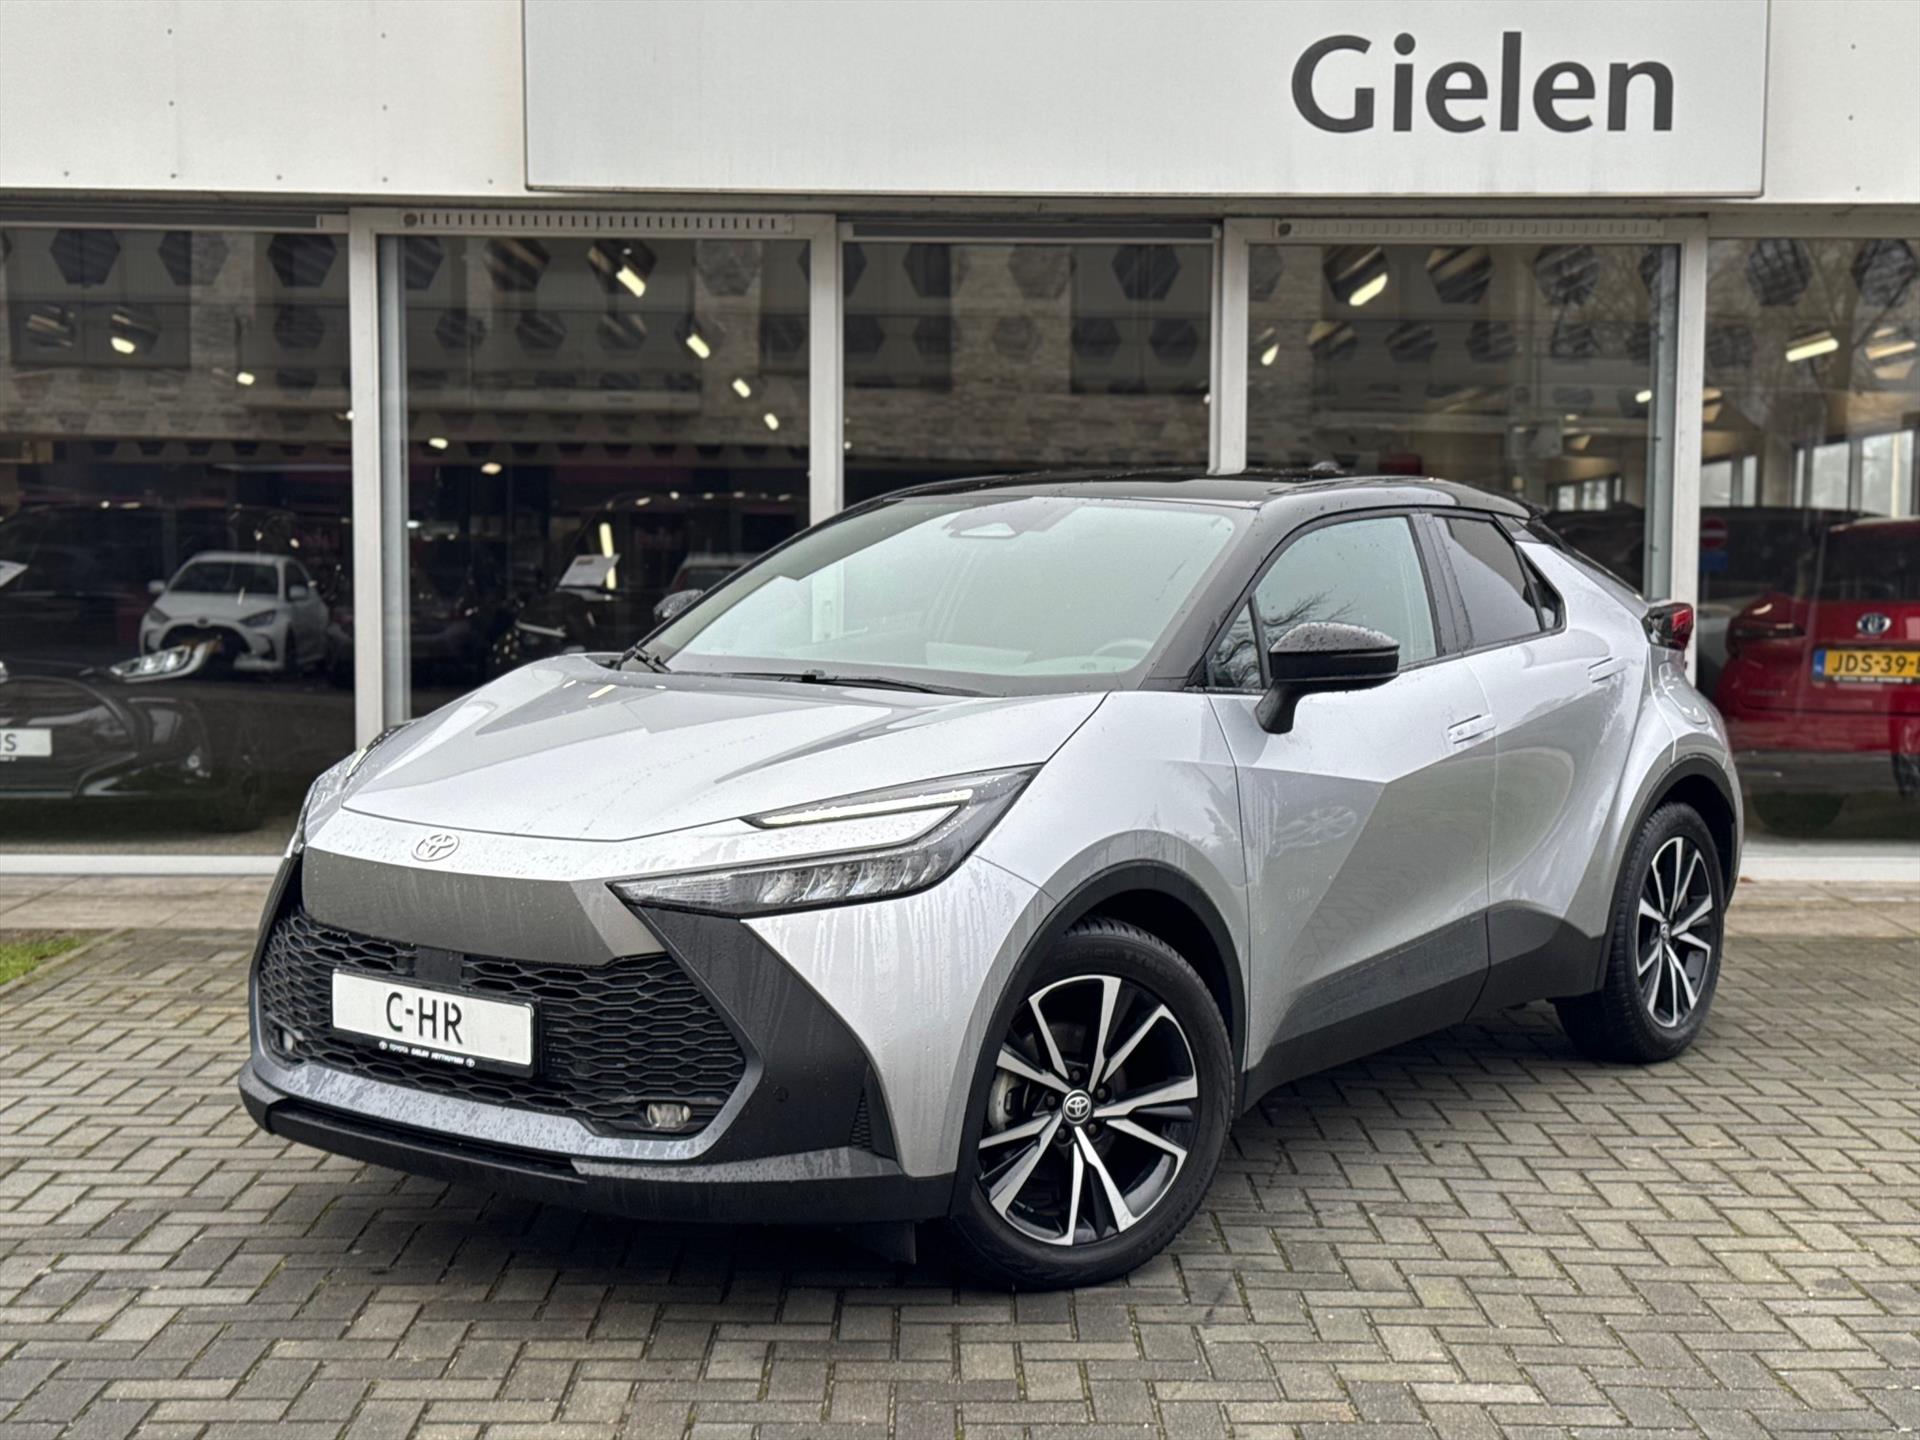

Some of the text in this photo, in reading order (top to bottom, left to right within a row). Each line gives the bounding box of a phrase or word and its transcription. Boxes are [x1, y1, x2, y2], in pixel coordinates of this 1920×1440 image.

[1291, 31, 1674, 133] Gielen
[0, 732, 17, 753] S
[387, 992, 463, 1044] C-HR
